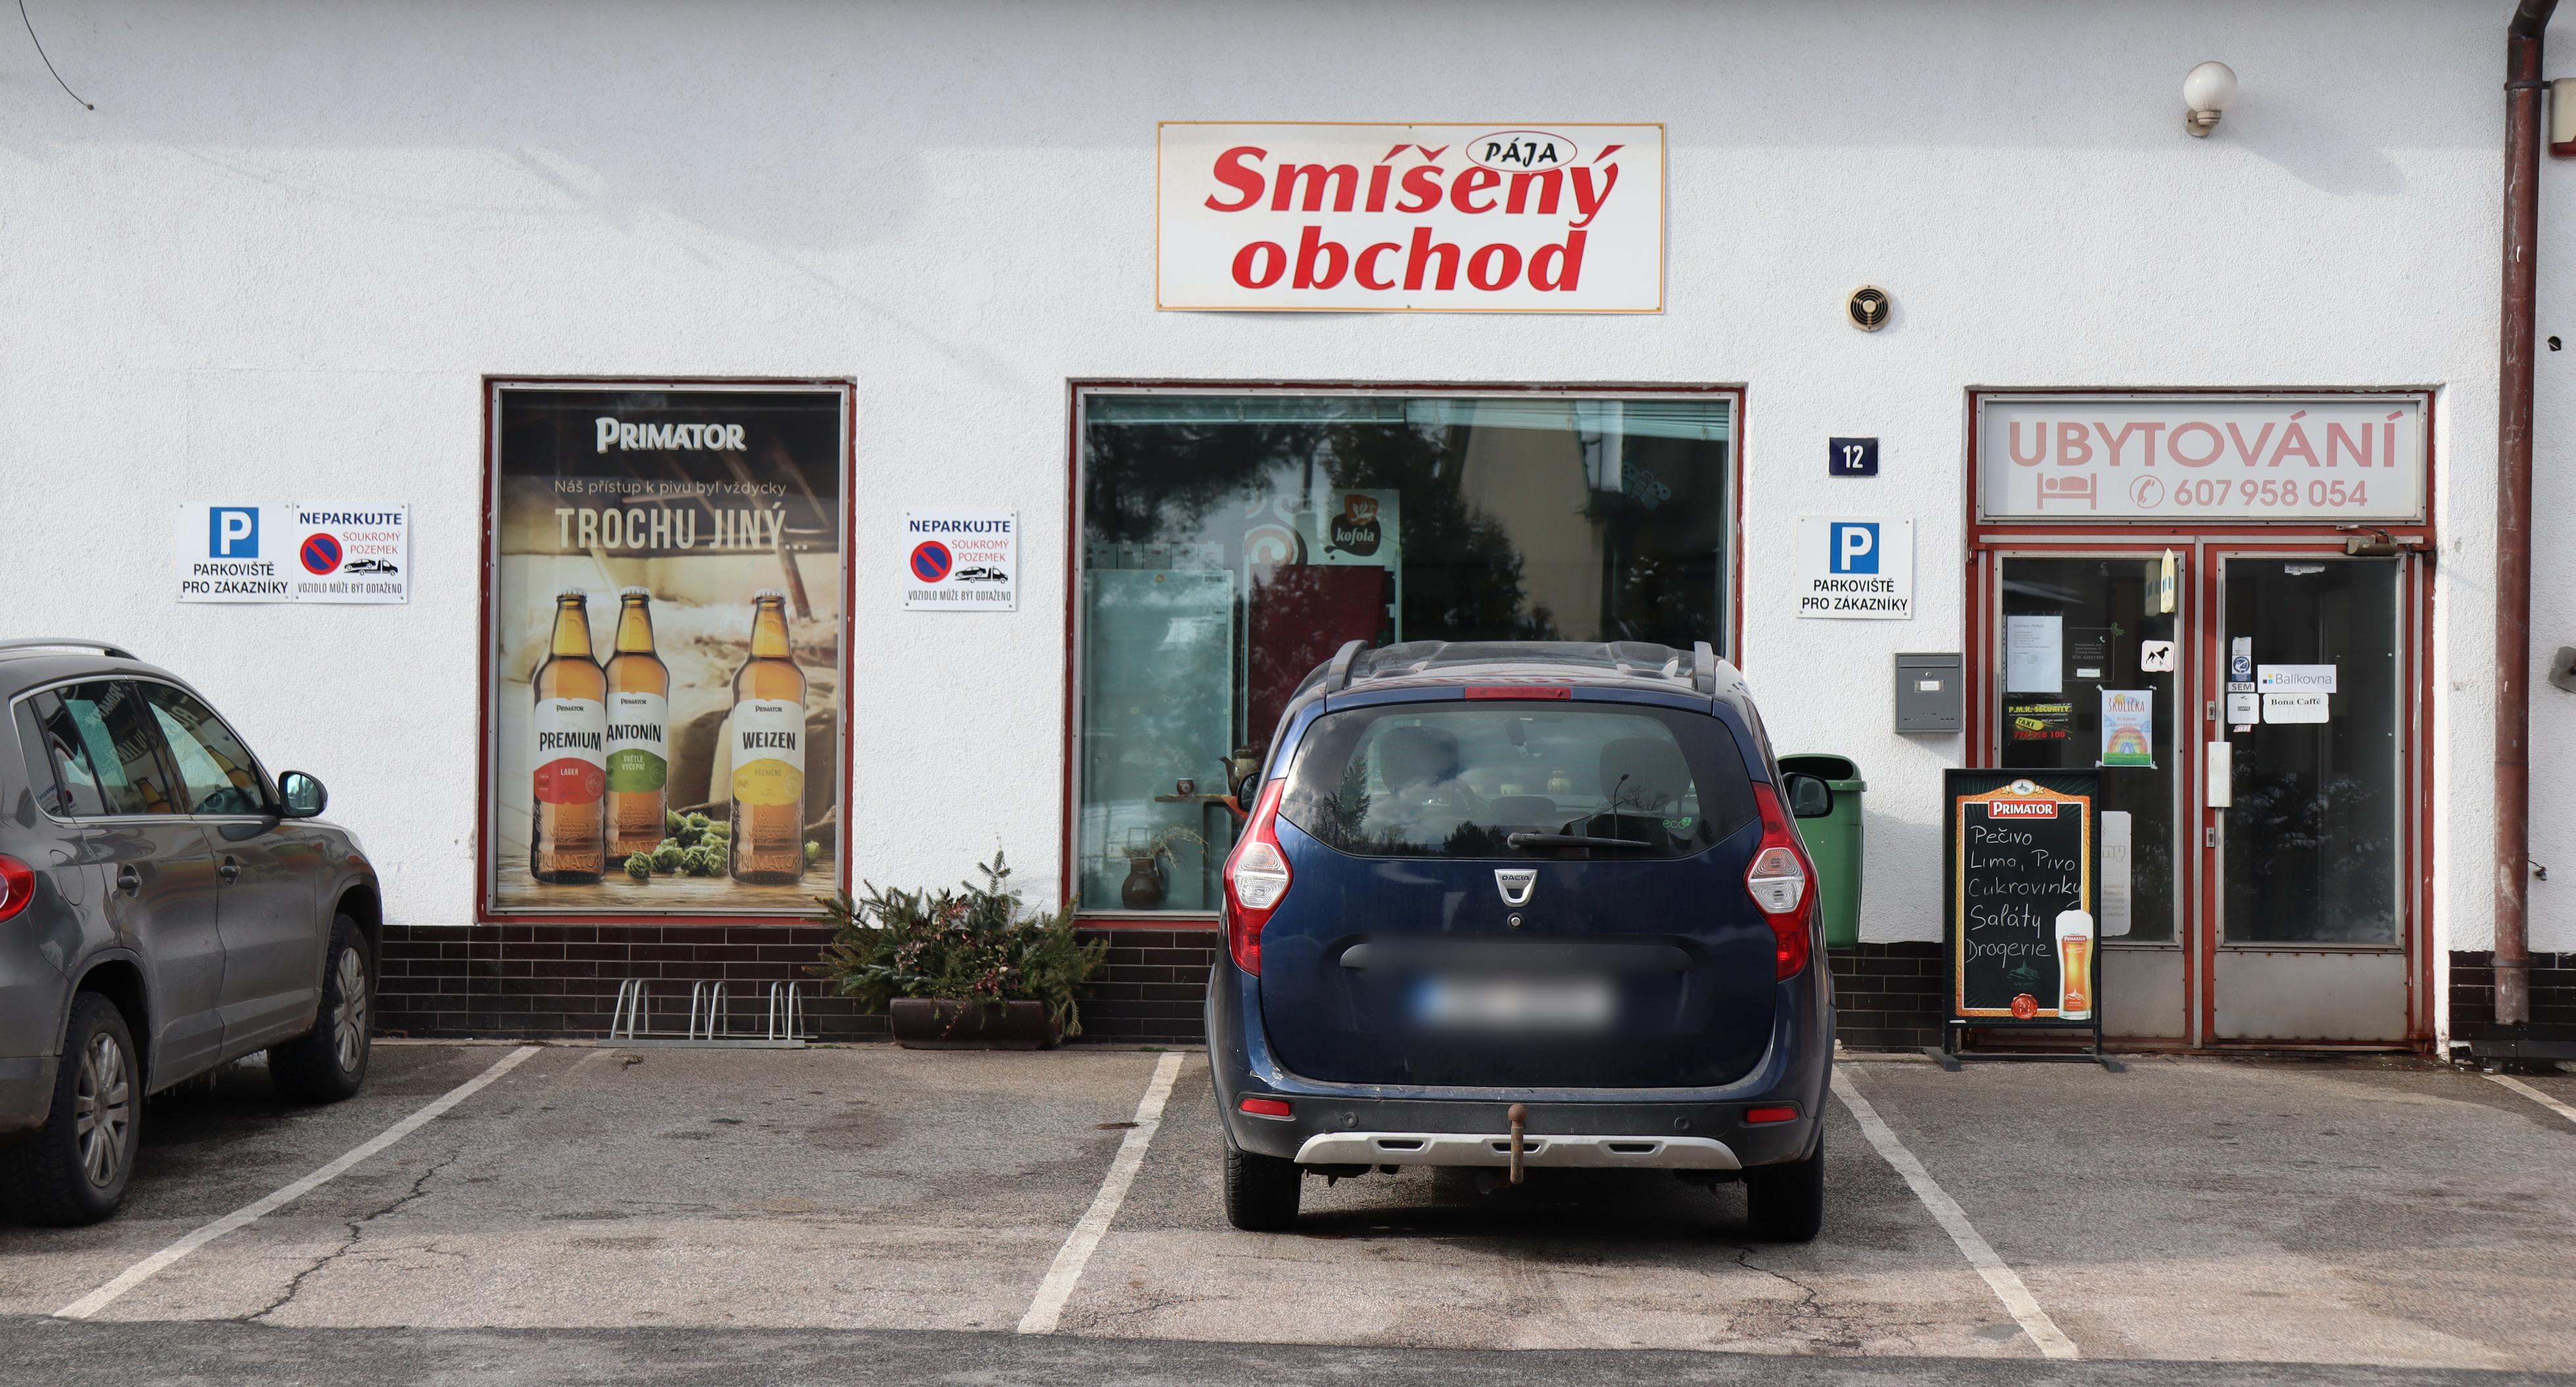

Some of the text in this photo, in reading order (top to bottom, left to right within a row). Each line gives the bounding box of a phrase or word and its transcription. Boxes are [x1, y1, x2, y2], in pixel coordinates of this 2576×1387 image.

[1485, 138, 1558, 167] PÁJA
[1203, 144, 1625, 228] Smíšený
[1231, 226, 1588, 292] obchod
[595, 416, 747, 454] PRIMATOR
[2009, 409, 2404, 468] UBYTOVÁNÍ
[1843, 445, 1863, 468] 12
[555, 480, 787, 497] Náš přístup k pivu byl vždycky
[2173, 478, 2368, 507] 607 958 054
[299, 513, 402, 525] NEPARKUJTE
[555, 508, 695, 549] TROCHU
[909, 520, 1011, 533] NEPARKUJTE
[220, 511, 252, 555] P
[343, 530, 401, 542] SOUKROMÝ
[1336, 526, 1375, 546] kofola
[350, 545, 398, 554] POZEMEK
[951, 538, 1009, 549] SOUKROMÝ
[1840, 526, 1873, 570] P
[958, 553, 1006, 562] POZEMEK
[193, 561, 274, 576] PARKOVIŠTĚ
[183, 578, 288, 594] PRO ZÁKAZNÍKY
[298, 582, 402, 593] VOZIDLO MŮŽE BÝT ODTAŽENO
[1813, 577, 1894, 593] PARKOVIŠTĚ
[908, 589, 1011, 601] VOZIDLO MŮŽE BÝT ODTAŽENO
[1802, 595, 1908, 611] PRO ZÁKAZNÍKY
[2275, 673, 2332, 685] Balíkovna
[2109, 697, 2145, 712] ŠKOLIČKA
[606, 722, 661, 743] ANTONÍN
[2018, 719, 2034, 728] TAXI
[540, 732, 601, 752] PREMIUM
[743, 732, 796, 751] WEIZEN
[1993, 801, 2053, 816] PRIMATOR
[1970, 825, 2033, 845] Pečivo
[1971, 849, 2075, 872] Limo, Pivo
[1968, 875, 2082, 908] Cukrovinky
[1970, 903, 2040, 938] Saláty
[1965, 938, 2051, 968] Drogerie
